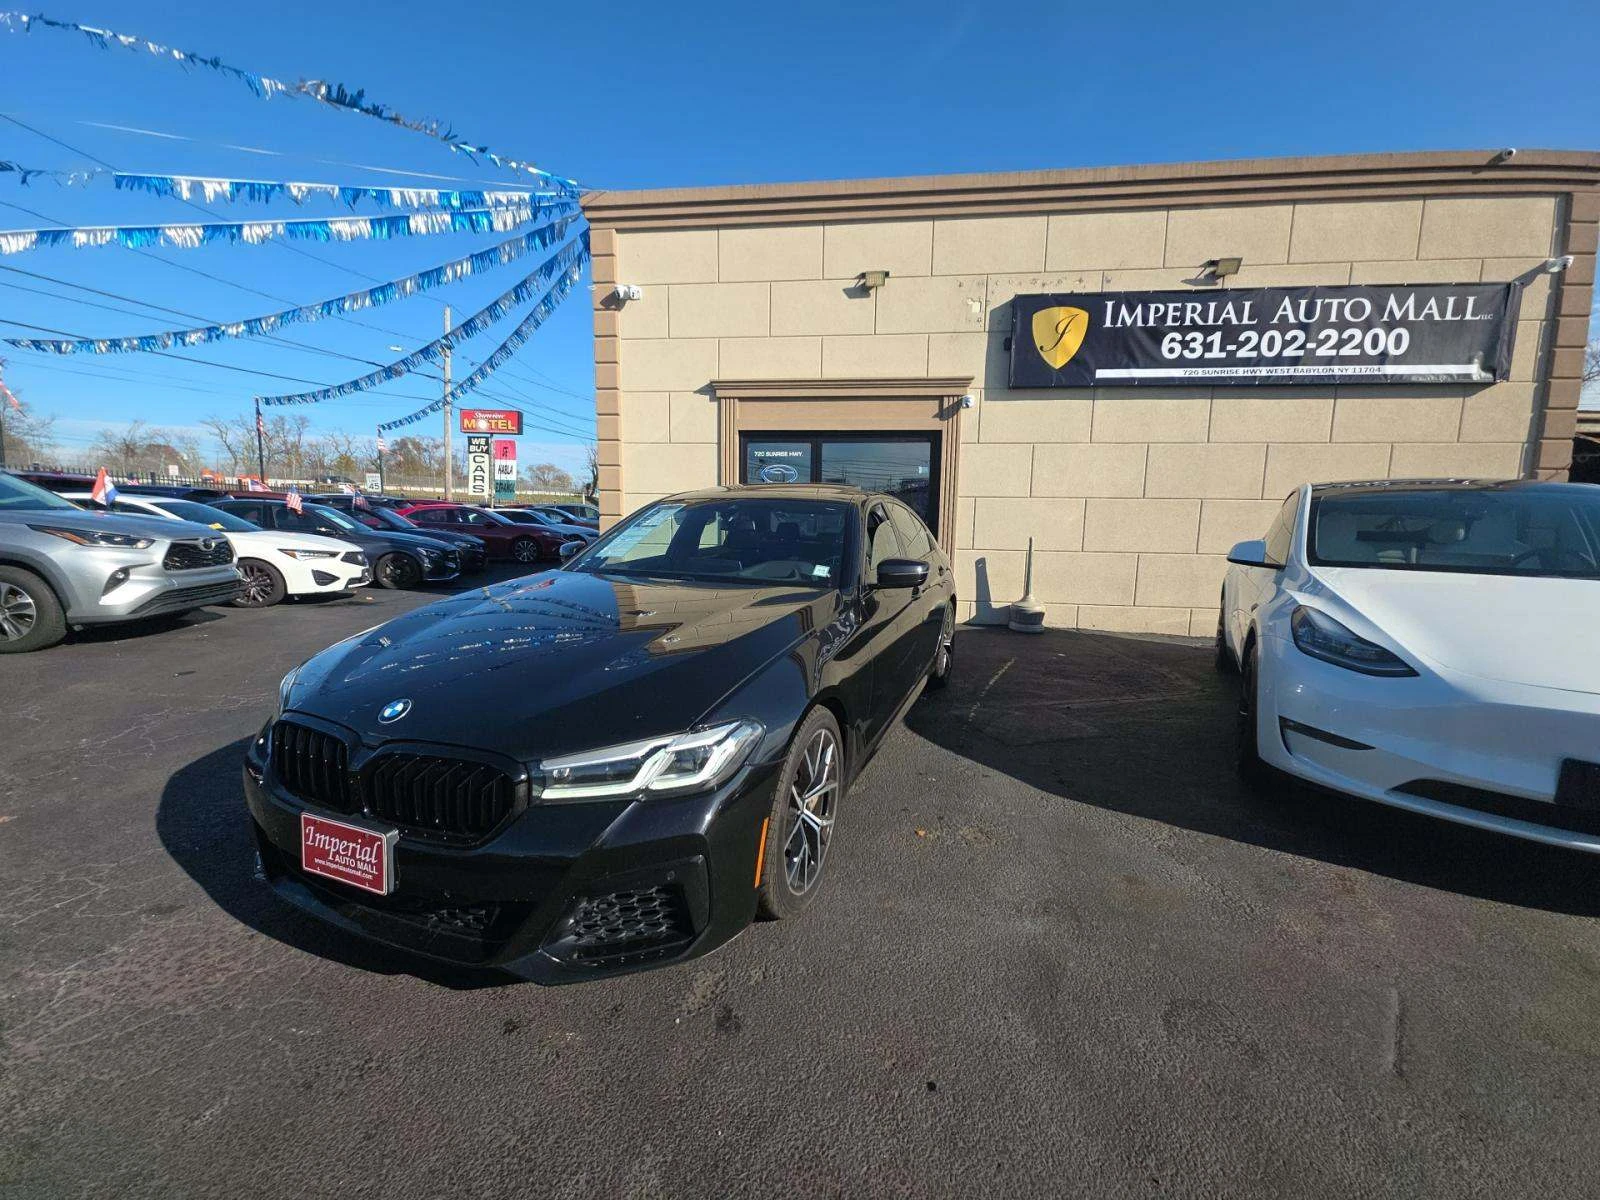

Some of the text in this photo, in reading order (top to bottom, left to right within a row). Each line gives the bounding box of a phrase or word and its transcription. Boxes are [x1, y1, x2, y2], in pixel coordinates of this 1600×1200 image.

[1103, 300, 1257, 328] IMPERIAL
[1270, 296, 1372, 324] AUTO
[1381, 292, 1483, 321] MALL
[1161, 328, 1410, 359] 631-202-2200
[1201, 368, 1241, 376] SUNRISE
[1265, 367, 1290, 375] WEST
[1293, 367, 1335, 375] BABYLON
[463, 418, 516, 430] MOTEL
[473, 455, 485, 493] CARS
[306, 826, 380, 863] Imperial
[335, 854, 378, 875] AUTO MALL
